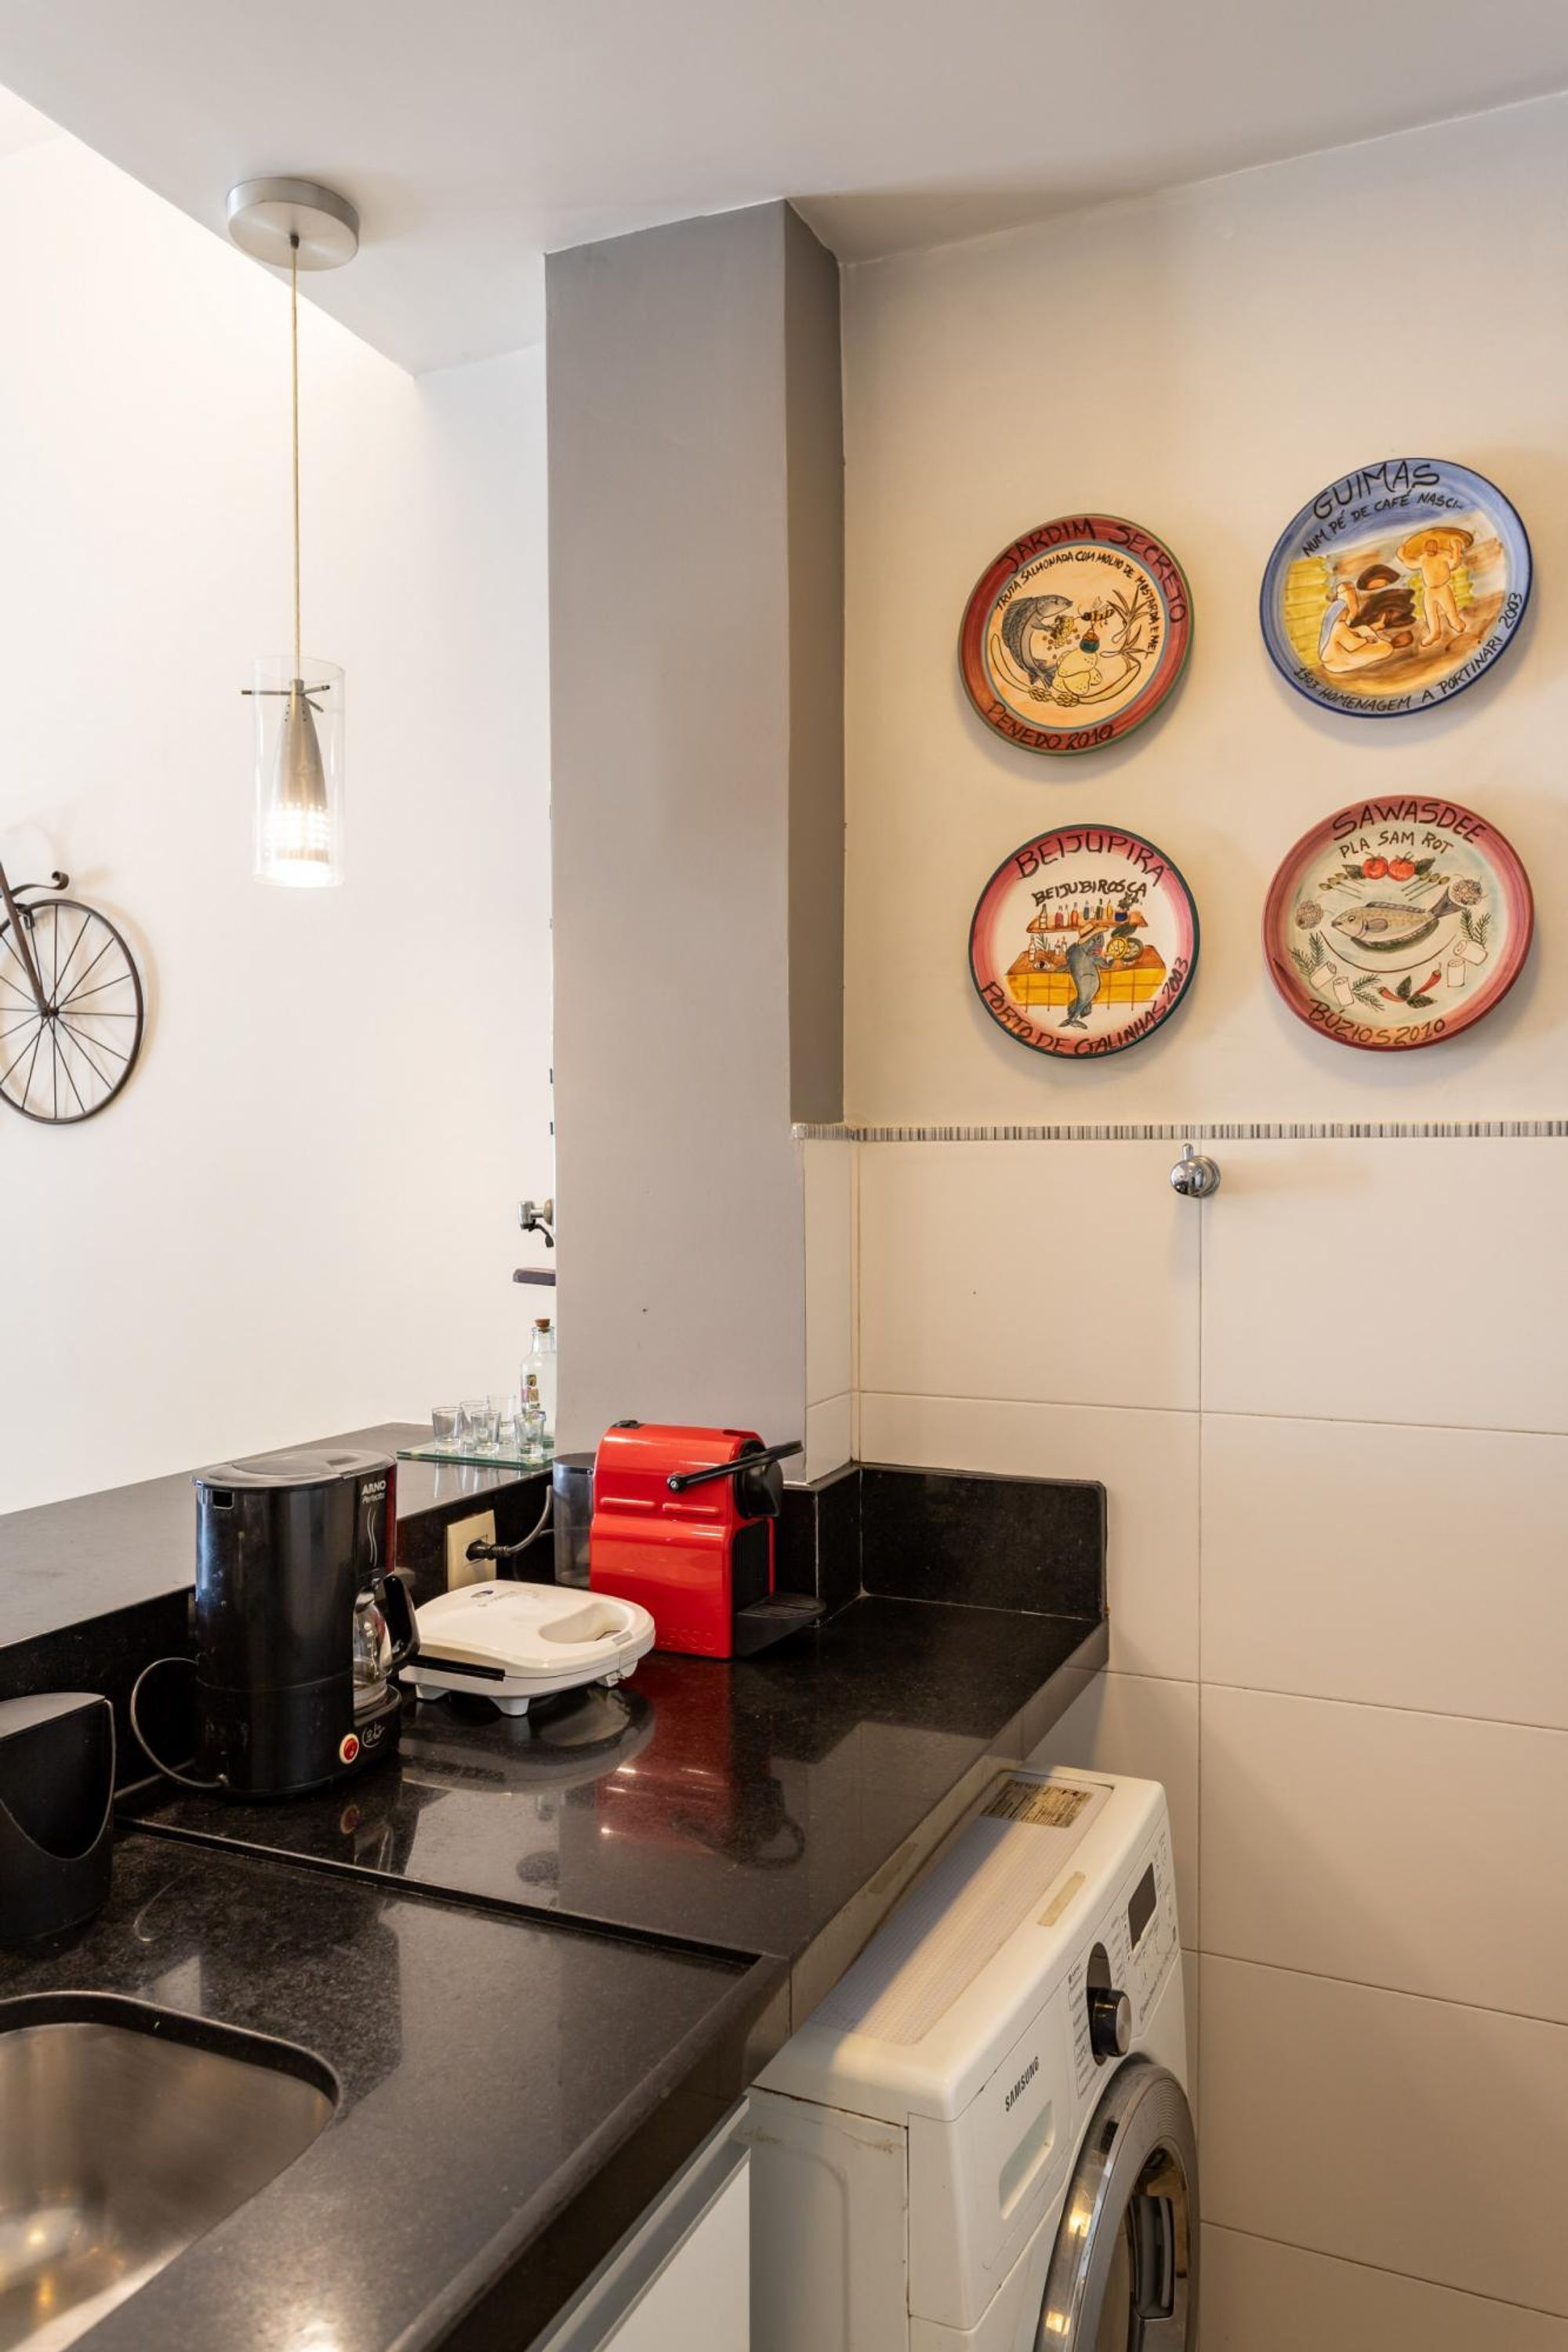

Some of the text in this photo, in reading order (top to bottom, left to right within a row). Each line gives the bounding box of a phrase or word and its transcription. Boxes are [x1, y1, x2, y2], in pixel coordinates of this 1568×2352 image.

[1313, 460, 1440, 520] GUIMAS
[1302, 529, 1330, 557] NUM
[1328, 509, 1346, 535] PÉ
[1350, 505, 1371, 522] DE
[1374, 489, 1412, 511] CAFÉ
[996, 579, 1022, 611] TRUTA
[1020, 551, 1073, 585] SALMONADA
[1075, 550, 1095, 562] COM
[1123, 564, 1135, 579] DE
[997, 517, 1186, 623] JARDIM SECRETO
[1318, 688, 1411, 712] HOMENAGEM
[1421, 689, 1435, 702] A
[1437, 636, 1503, 695] PORTINARI
[1498, 592, 1523, 629] 2003
[987, 700, 1113, 750] PENEDO 2010
[1331, 800, 1488, 844] SAWASDEE
[1340, 830, 1454, 858] PLA SAM ROT
[1014, 831, 1178, 887] BEIJUPIRÁ
[982, 956, 1189, 1054] PORTO DE GALINHAS 2003
[1309, 999, 1445, 1045] BÚZIOS 2010
[361, 1480, 387, 1495] ARNO
[1005, 2056, 1039, 2112] SAMSUNG
